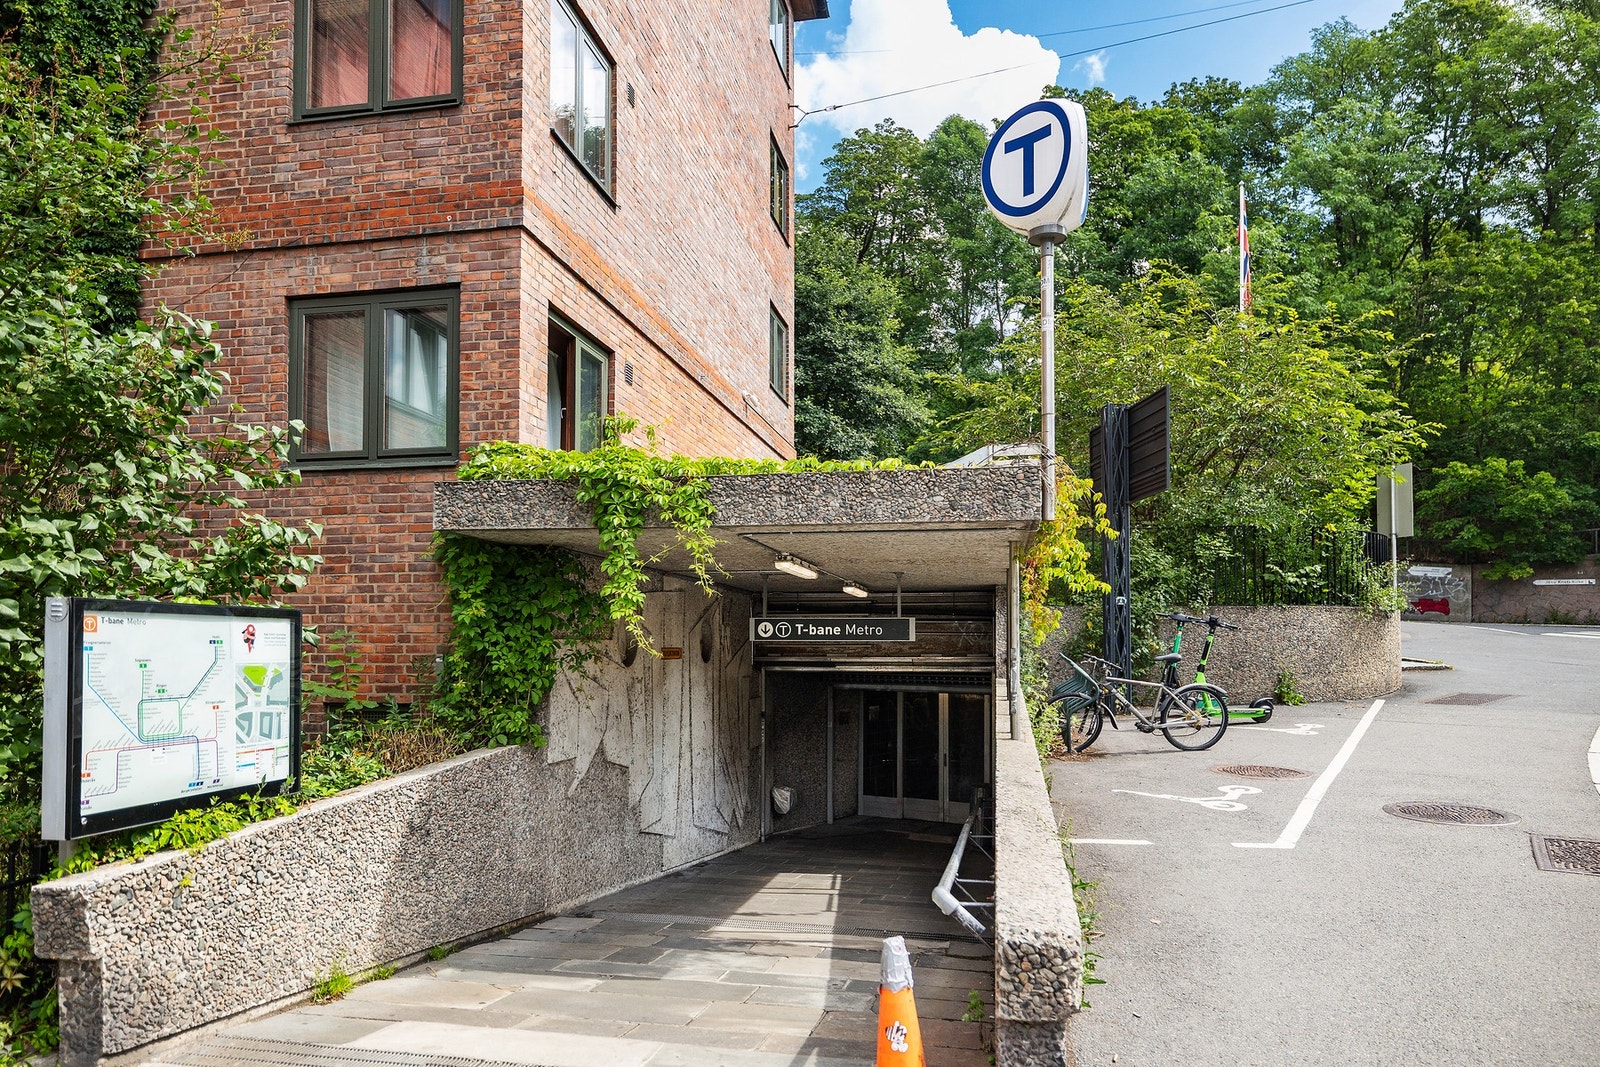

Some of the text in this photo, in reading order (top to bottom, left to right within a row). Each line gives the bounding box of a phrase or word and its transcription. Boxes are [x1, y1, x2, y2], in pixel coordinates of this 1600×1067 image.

[1004, 123, 1052, 197] T
[100, 616, 125, 625] T-bane
[126, 617, 147, 626] Metro
[795, 623, 841, 636] T-bane
[845, 623, 884, 636] Metro
